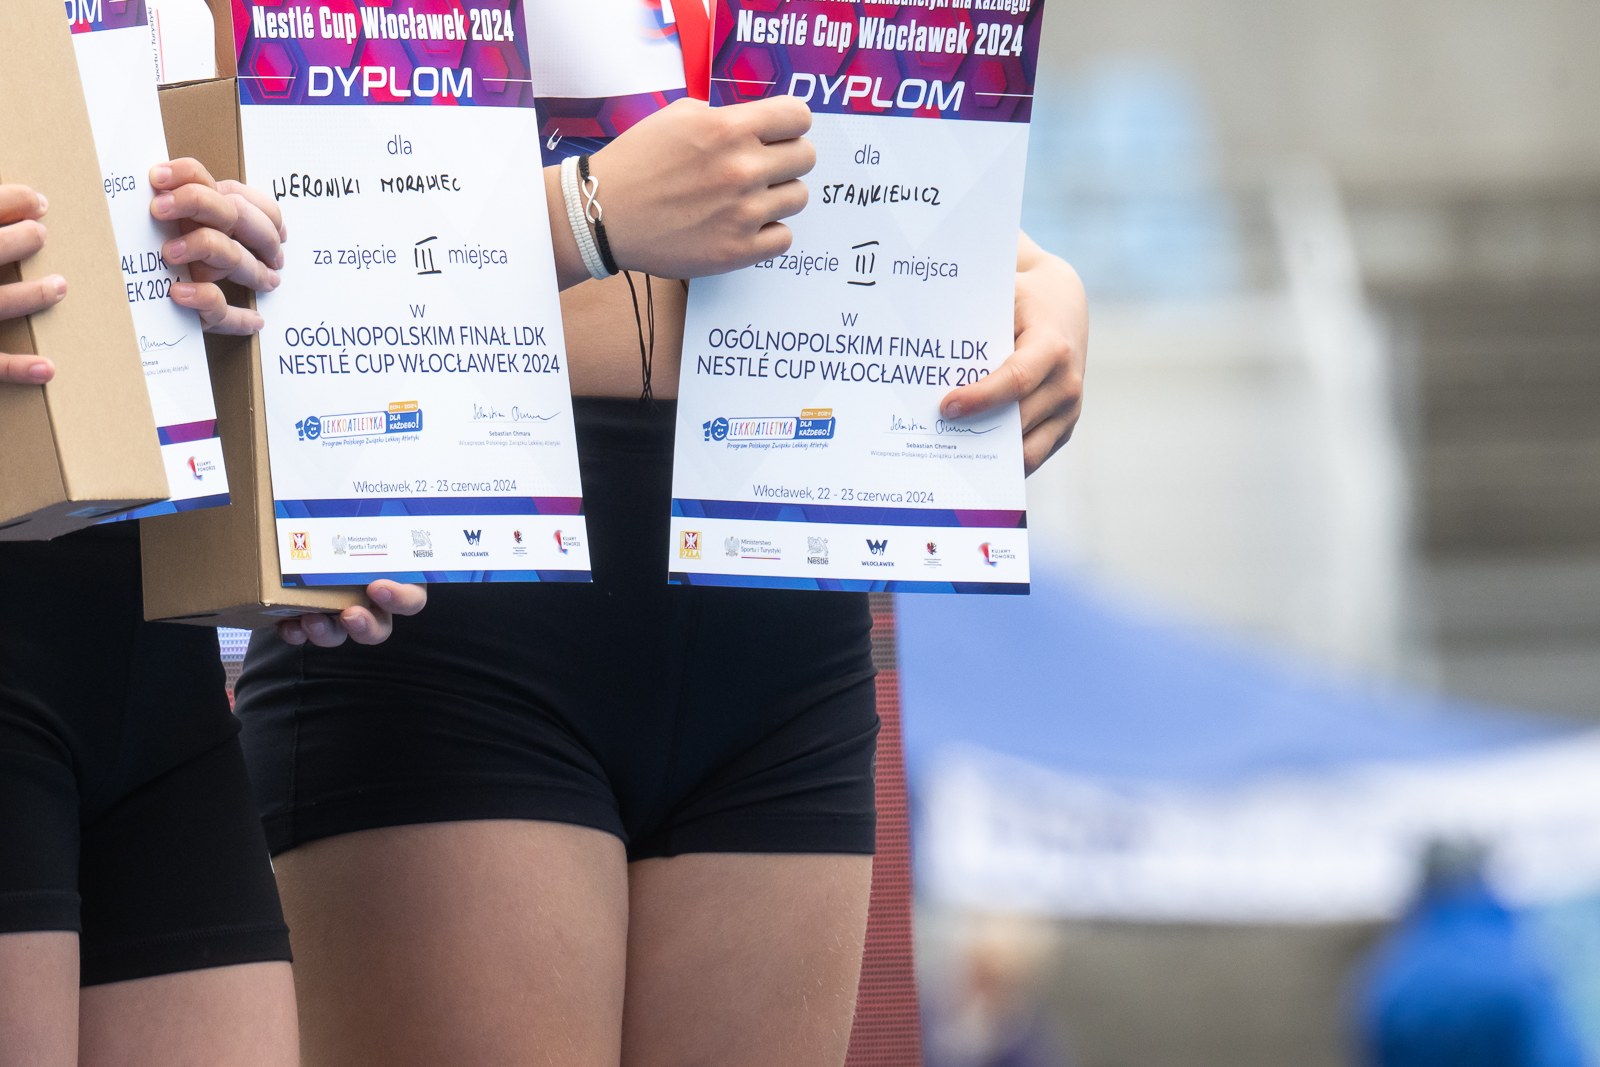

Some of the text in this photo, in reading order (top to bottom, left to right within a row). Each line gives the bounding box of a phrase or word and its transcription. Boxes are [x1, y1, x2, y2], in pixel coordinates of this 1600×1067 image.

[252, 5, 514, 44] Nestlé Cup Włocławek 2024
[736, 10, 1024, 57] Nestlé Cup Włocławek 2024
[308, 66, 473, 98] DYPLOM
[787, 72, 966, 112] DYPLOM
[386, 134, 413, 155] dla
[854, 144, 880, 166] dla
[104, 172, 135, 198] ejsca
[272, 174, 461, 201] WERONIKI MORAWIEC
[822, 184, 941, 208] STANKIEWICZ
[140, 251, 168, 272] LDK
[313, 249, 333, 265] za
[337, 245, 397, 270] zajęcie
[448, 246, 508, 269] miejsca
[779, 250, 839, 275] zajęcie
[893, 256, 959, 281] miejsca
[147, 276, 180, 300] 202
[285, 322, 547, 347] OGÓLNOPOLSKIM FINAŁ LDK
[708, 324, 989, 361] OGÓLNOPOLSKIM FINAŁ LDK
[279, 348, 560, 375] NESTLÉ CUP WŁOCŁAWEK 2024
[697, 352, 769, 379] NESTLÉ
[774, 359, 815, 381] CUP
[820, 360, 950, 387] WŁOCŁAWEK
[323, 416, 383, 434] LEKKOATLETYKA
[390, 413, 419, 430] KAŻDEGO!
[730, 422, 793, 436] LEKKOATLETYKA
[799, 420, 832, 436] KAŻDEGO!
[353, 479, 517, 493] Włocławek, 22 23 czerwca 2024
[753, 484, 935, 504] Włocławek, 22 23 czerwca 2024
